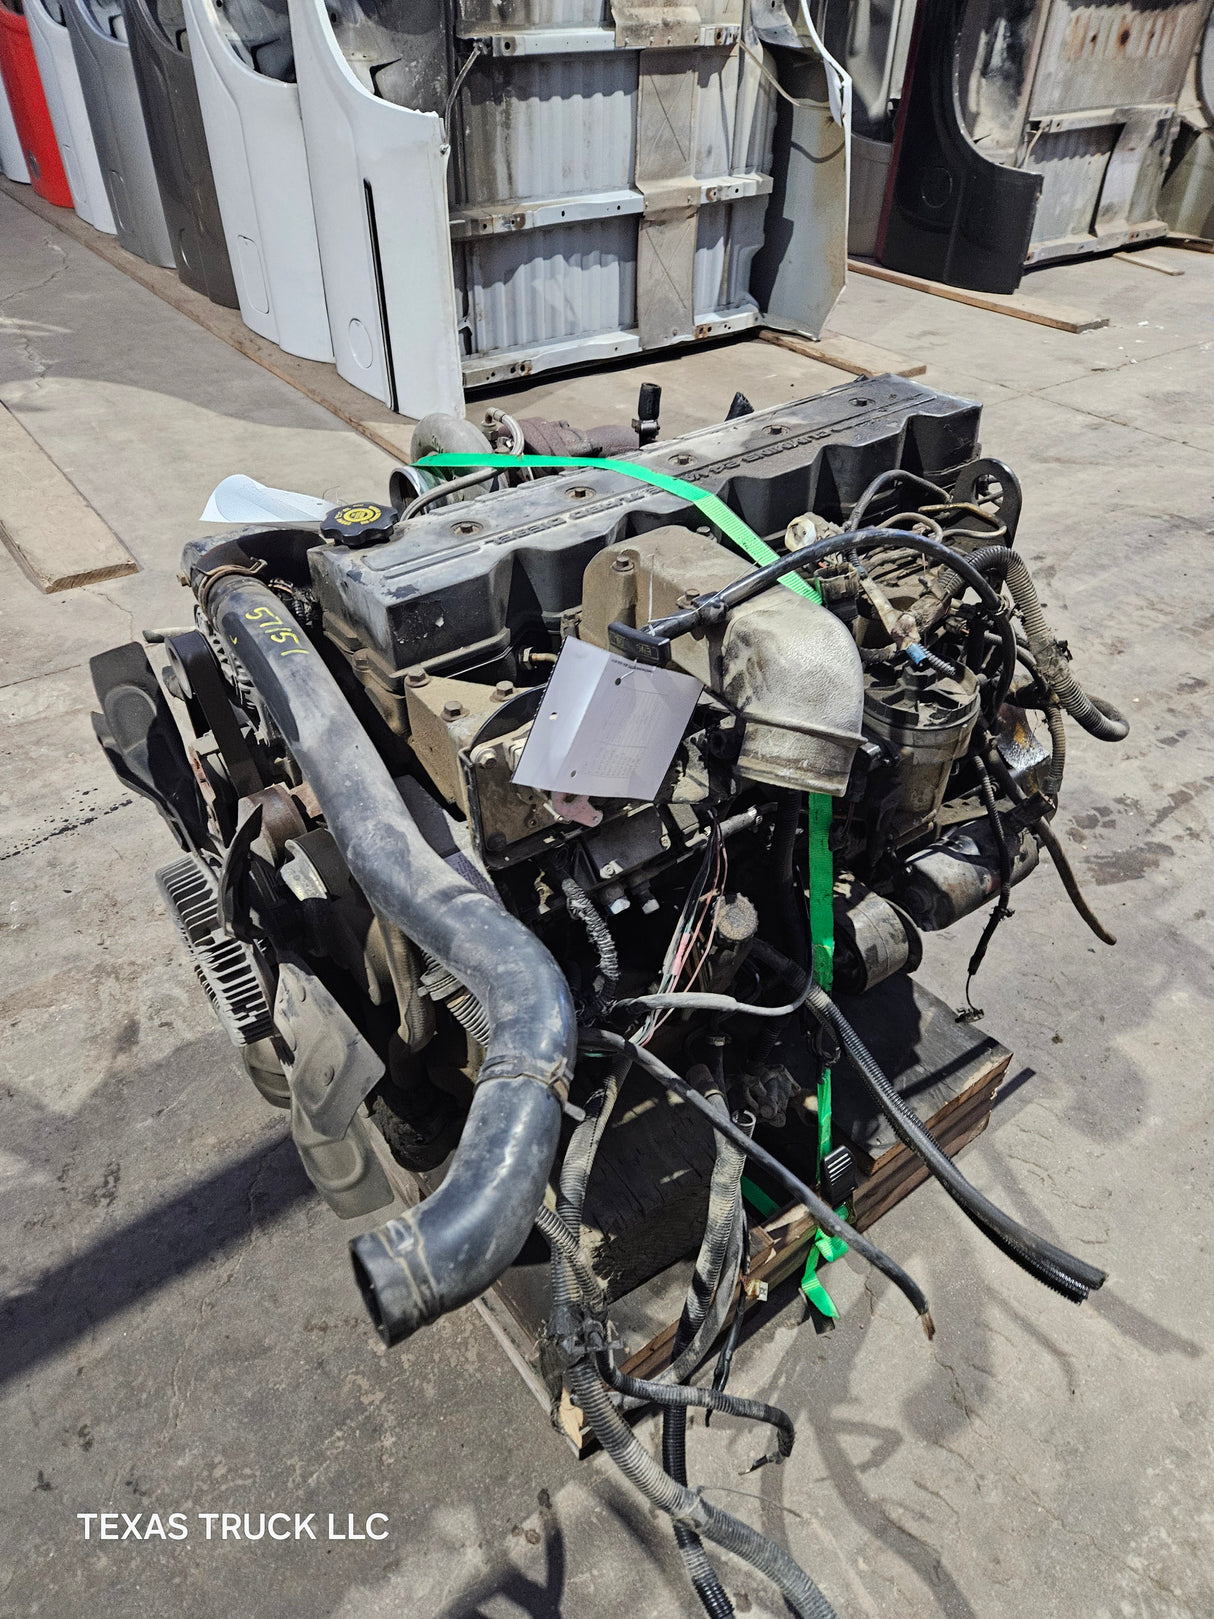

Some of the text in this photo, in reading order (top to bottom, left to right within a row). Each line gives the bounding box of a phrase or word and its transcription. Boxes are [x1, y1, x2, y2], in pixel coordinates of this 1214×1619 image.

[741, 427, 832, 463] CUMMINS
[485, 517, 568, 546] DIESEL
[245, 606, 310, 657] 57151
